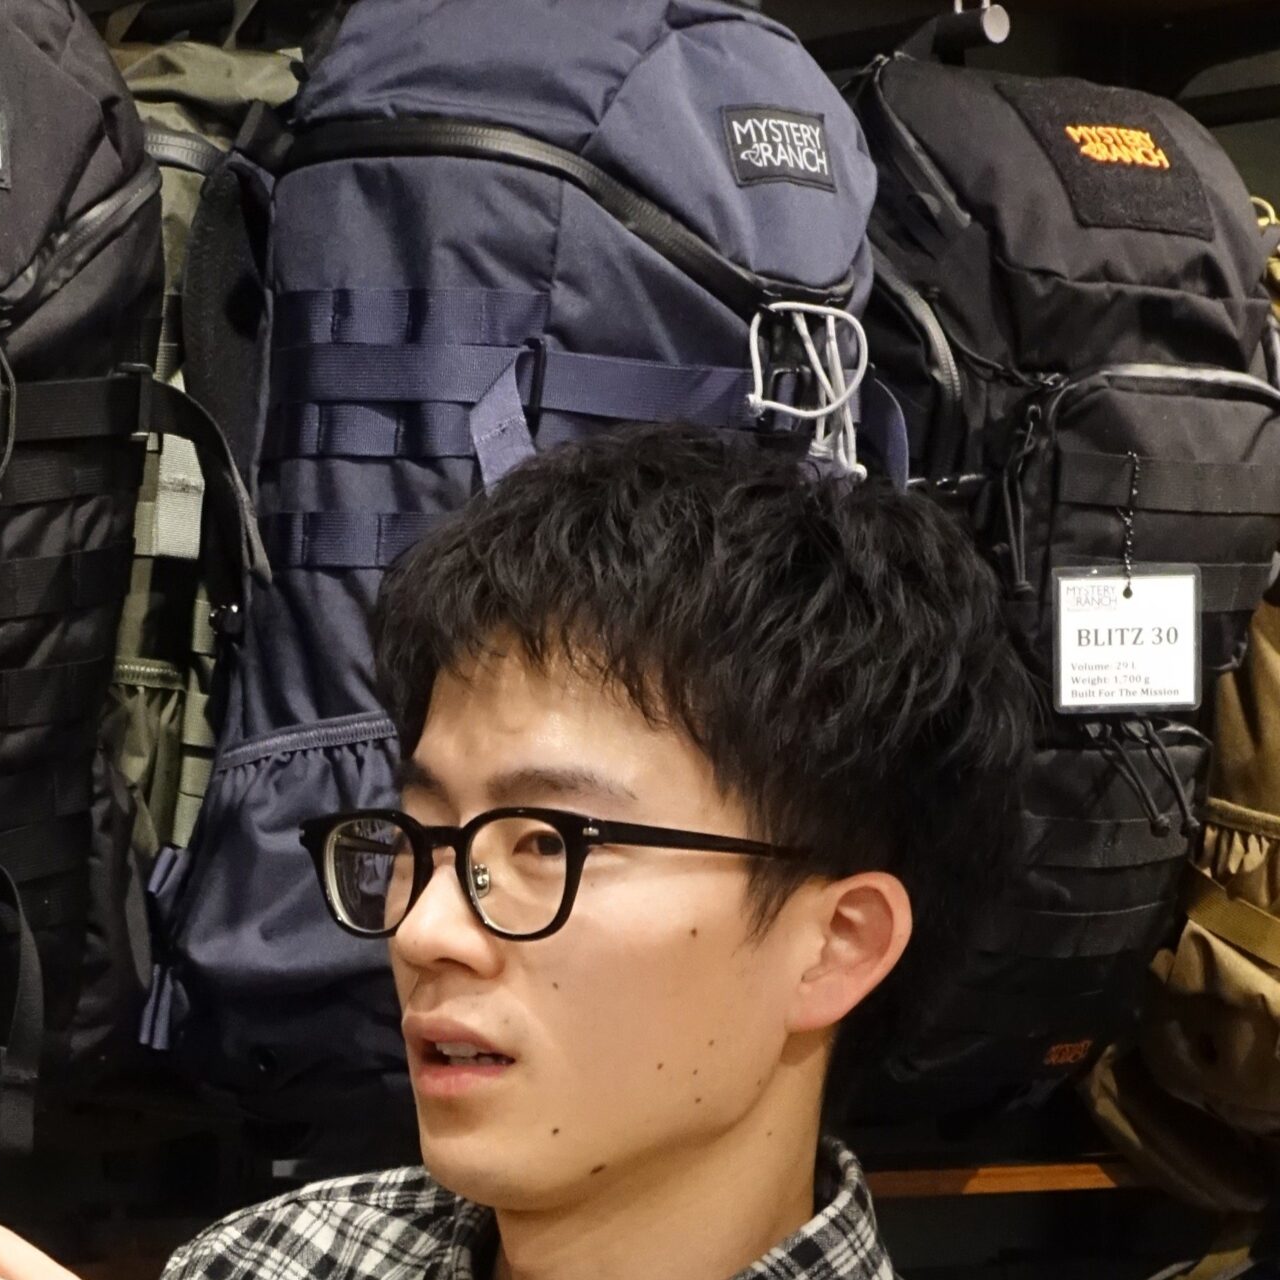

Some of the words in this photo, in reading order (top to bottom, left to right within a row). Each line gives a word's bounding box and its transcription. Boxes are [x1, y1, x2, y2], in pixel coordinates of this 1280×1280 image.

[732, 118, 821, 150] MYSTERY
[1065, 125, 1156, 150] MYSTERY
[759, 142, 829, 176] RANCH
[1066, 584, 1117, 597] MYSTERY
[1076, 595, 1118, 607] RANCH
[1077, 627, 1145, 647] BLITZ
[1151, 626, 1179, 646] 30
[1144, 676, 1151, 685] g
[1071, 688, 1096, 698] Built
[1098, 688, 1116, 698] For
[1119, 687, 1138, 697] The
[1140, 687, 1180, 697] Mission
